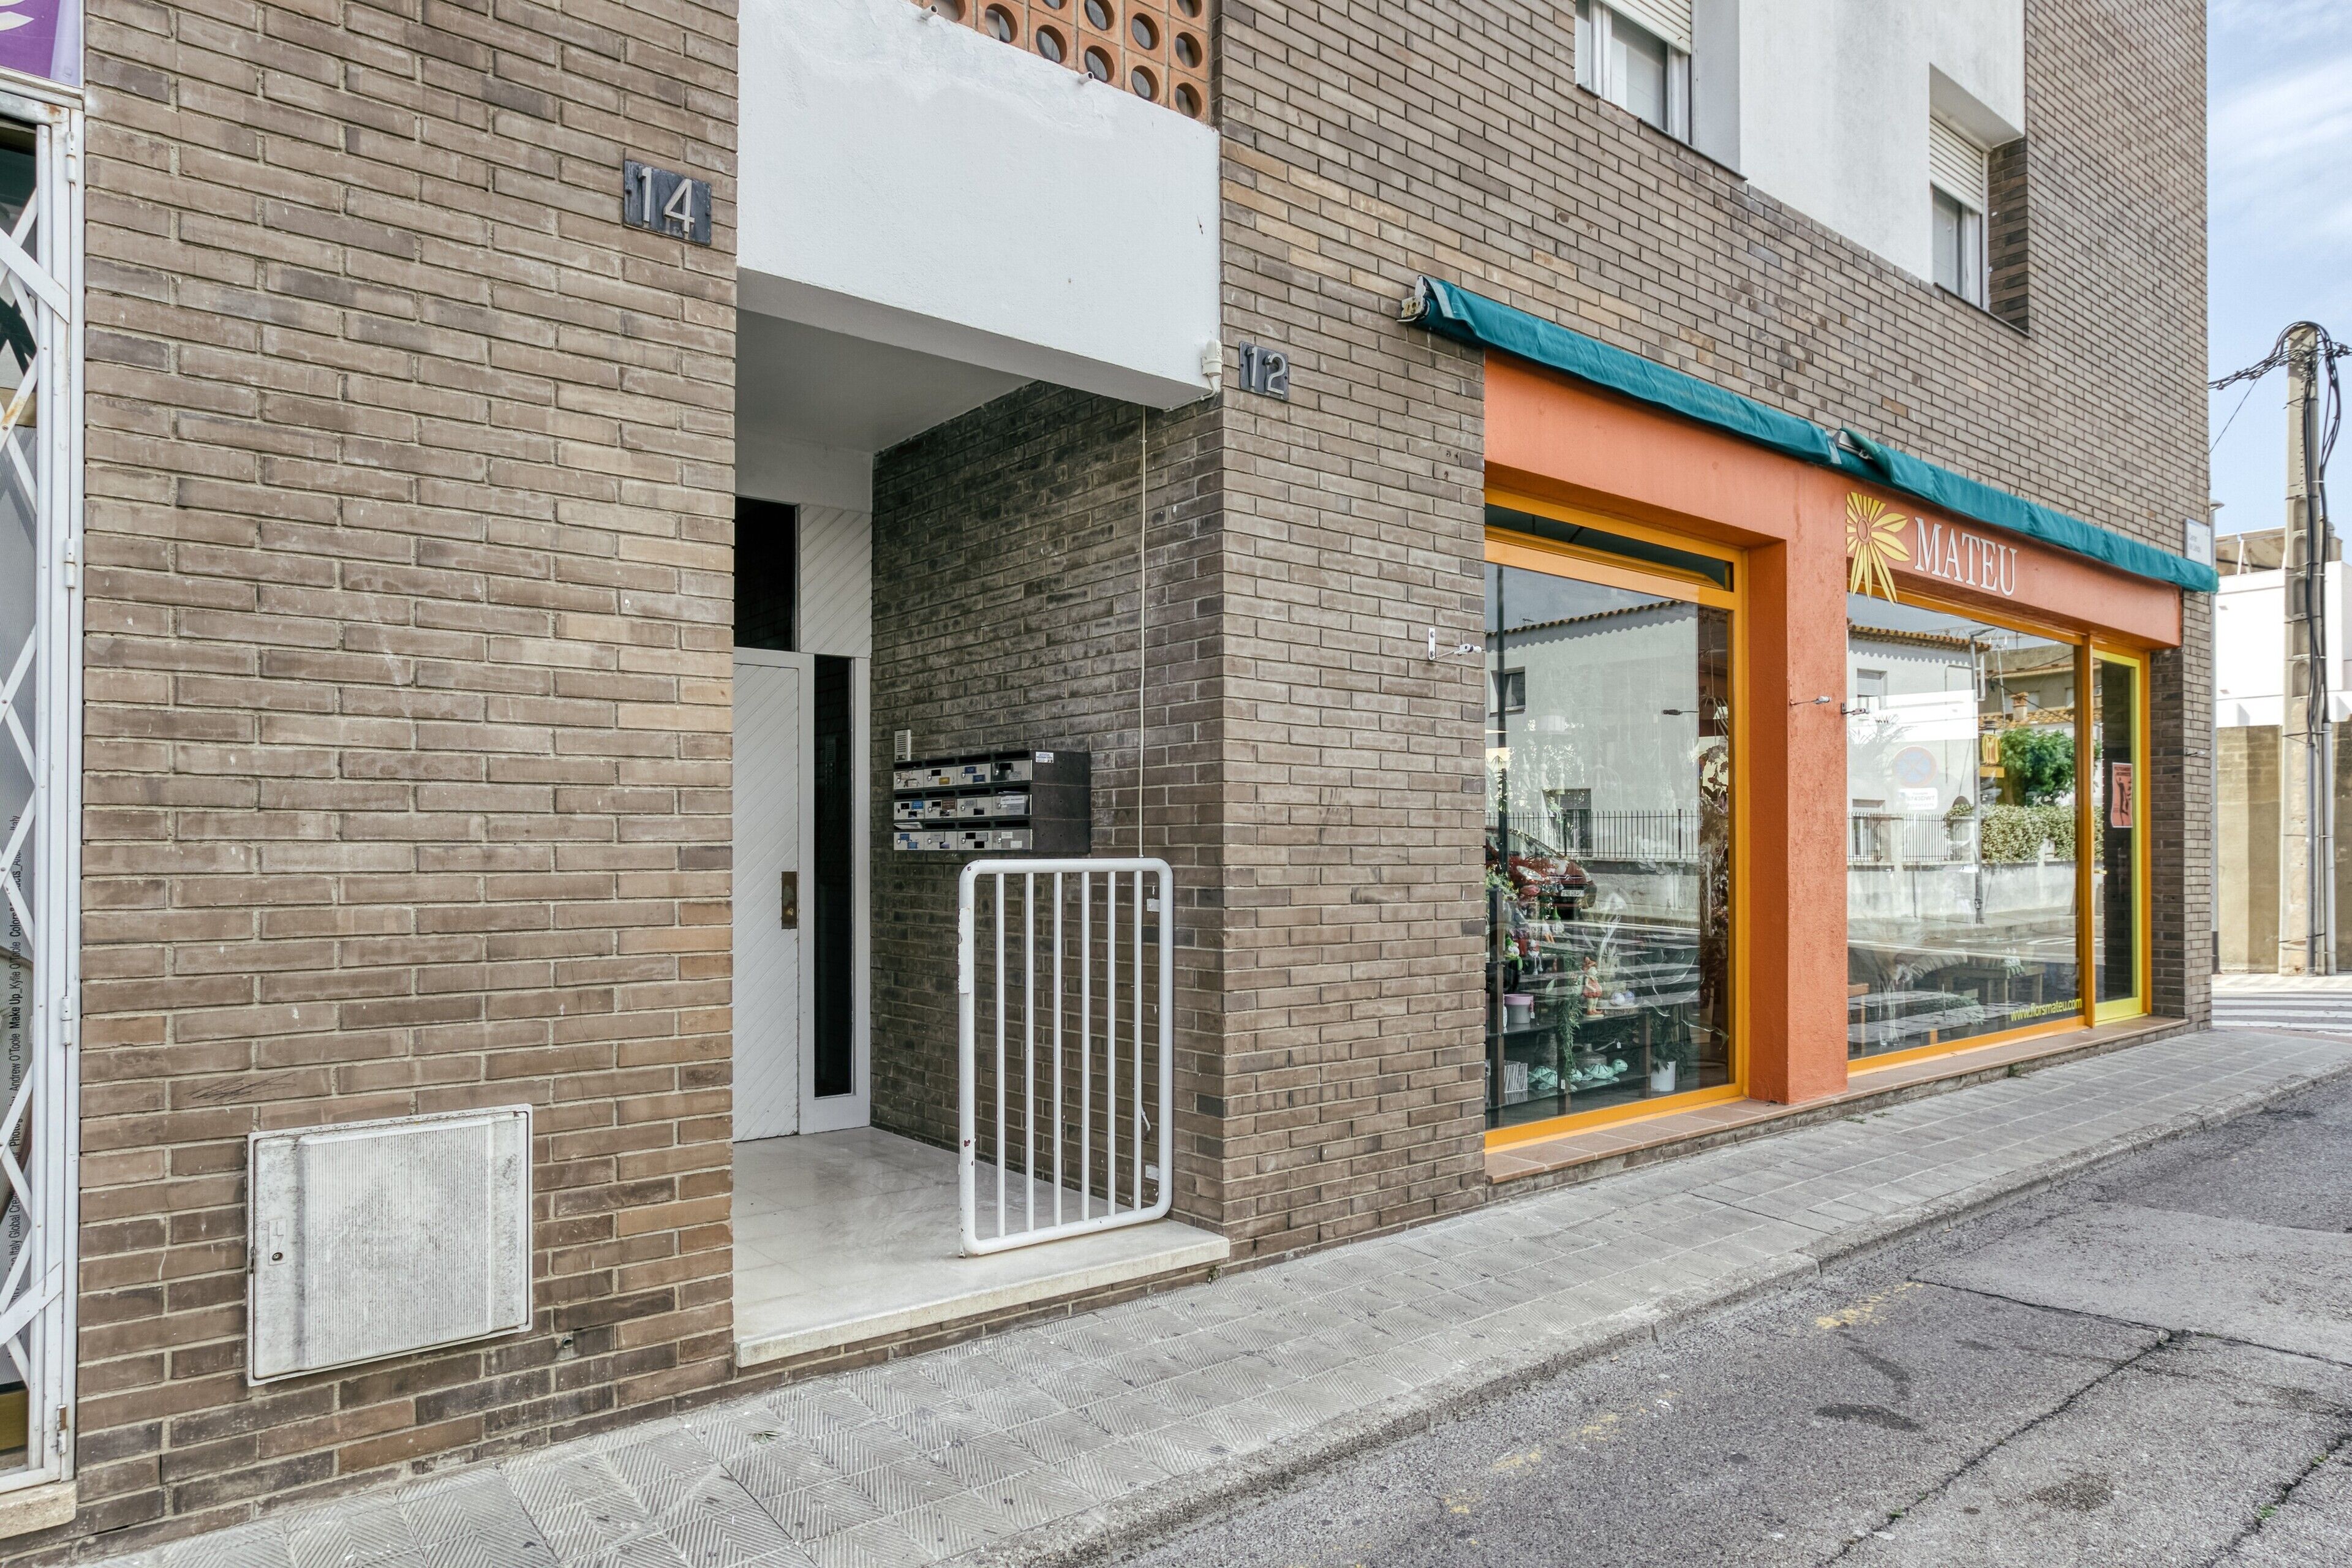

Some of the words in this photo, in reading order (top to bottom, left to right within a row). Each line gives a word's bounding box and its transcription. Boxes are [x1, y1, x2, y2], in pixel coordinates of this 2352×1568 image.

[638, 166, 695, 233] 14
[1246, 346, 1286, 395] 12
[1914, 516, 2018, 597] MATEU
[9, 942, 20, 969] O'Toole
[9, 1007, 20, 1029] Make
[2010, 998, 2082, 1022] www.florsmateu.com
[9, 1033, 20, 1061] O'Toole
[9, 1064, 20, 1091] Andrew
[9, 1215, 20, 1238] Global
